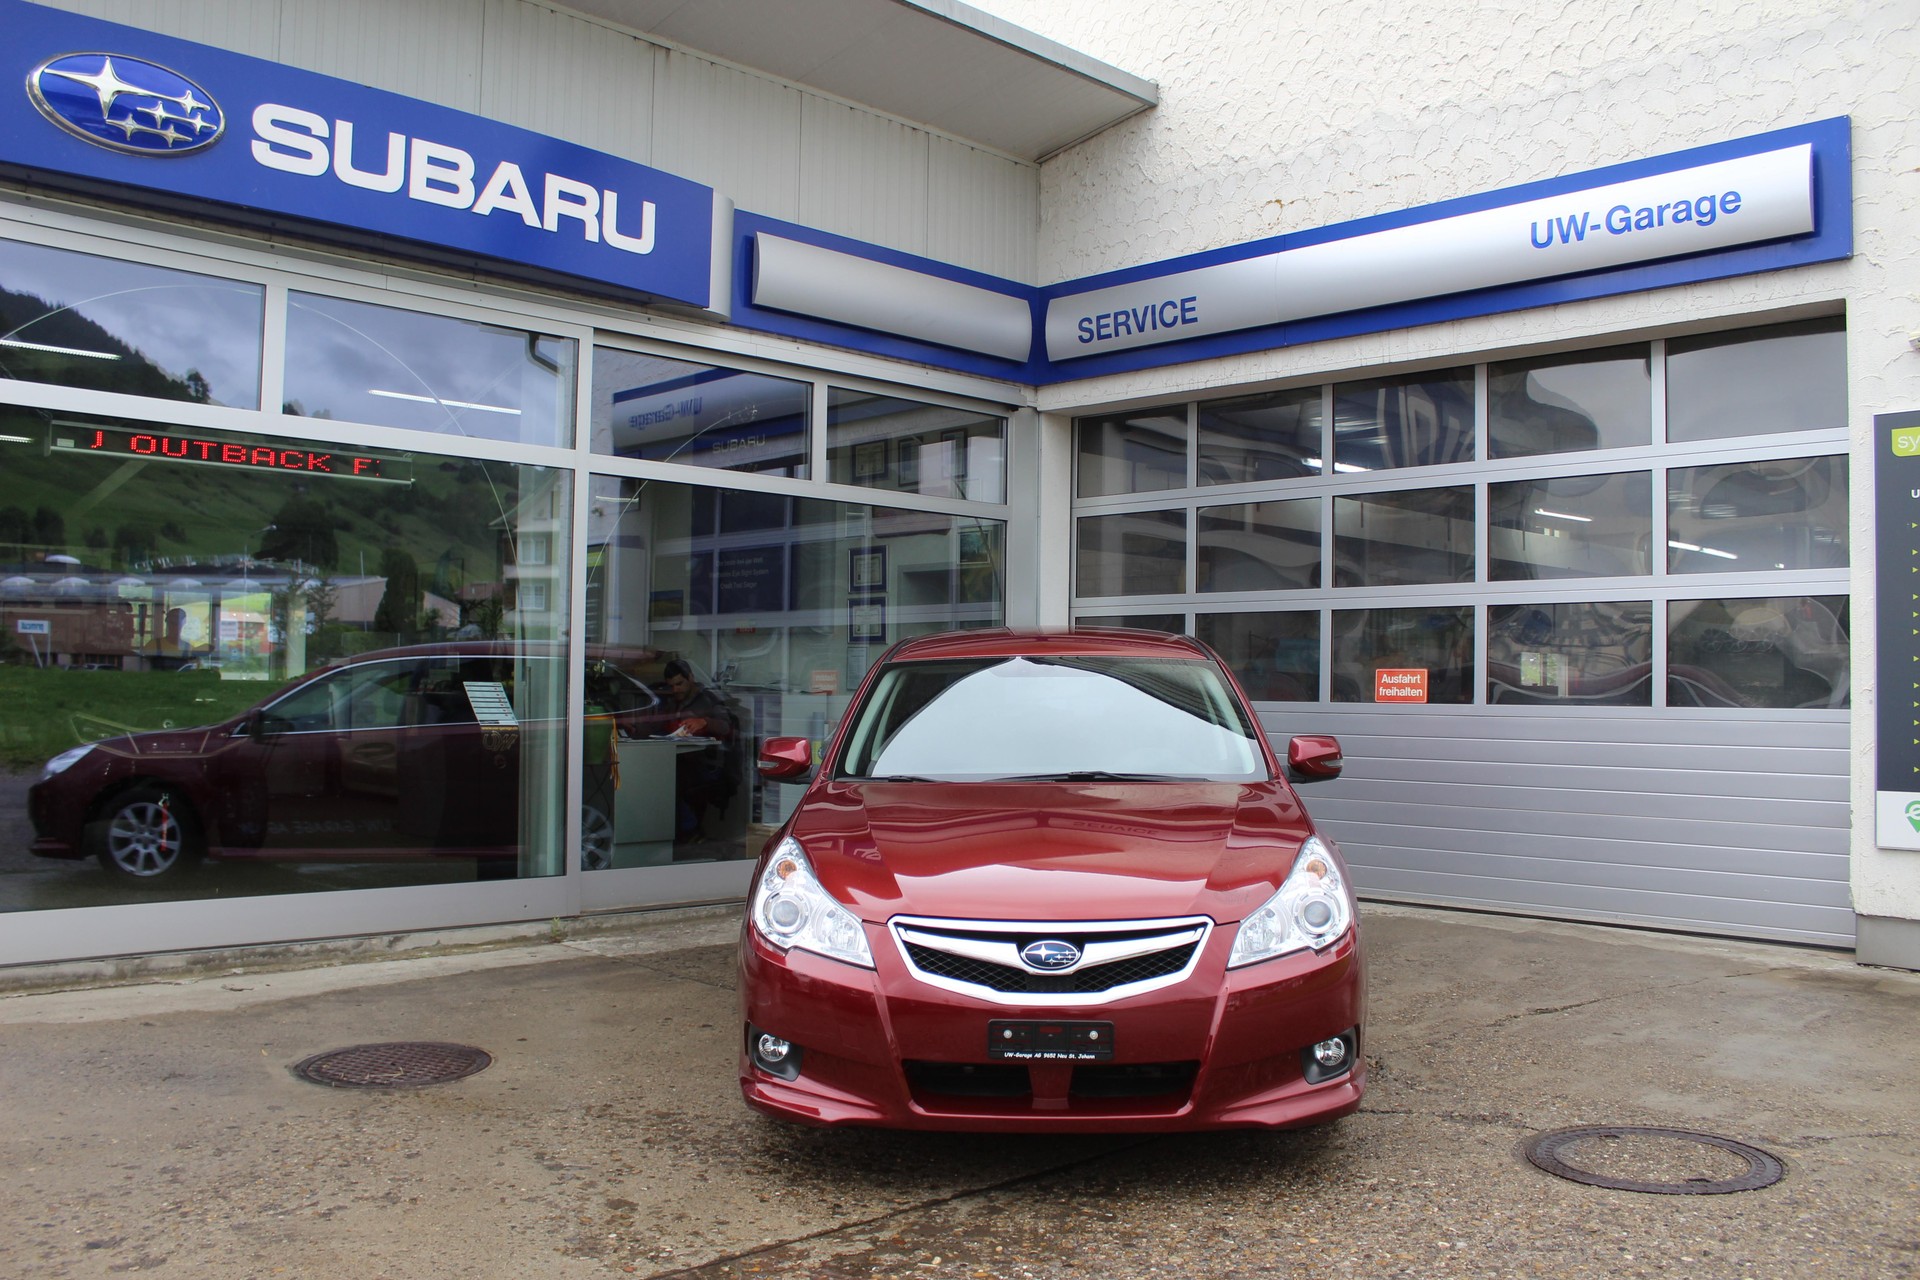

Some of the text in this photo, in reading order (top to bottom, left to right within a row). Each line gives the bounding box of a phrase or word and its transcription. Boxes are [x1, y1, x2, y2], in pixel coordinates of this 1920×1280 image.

[251, 103, 656, 255] SUBARU
[1530, 190, 1742, 249] UW-Garage
[1077, 296, 1199, 344] SERVICE
[130, 434, 331, 472] OUTBACK
[712, 433, 766, 454] SUBARU
[1379, 687, 1422, 697] freihalten
[1381, 673, 1421, 684] Ausfahrt
